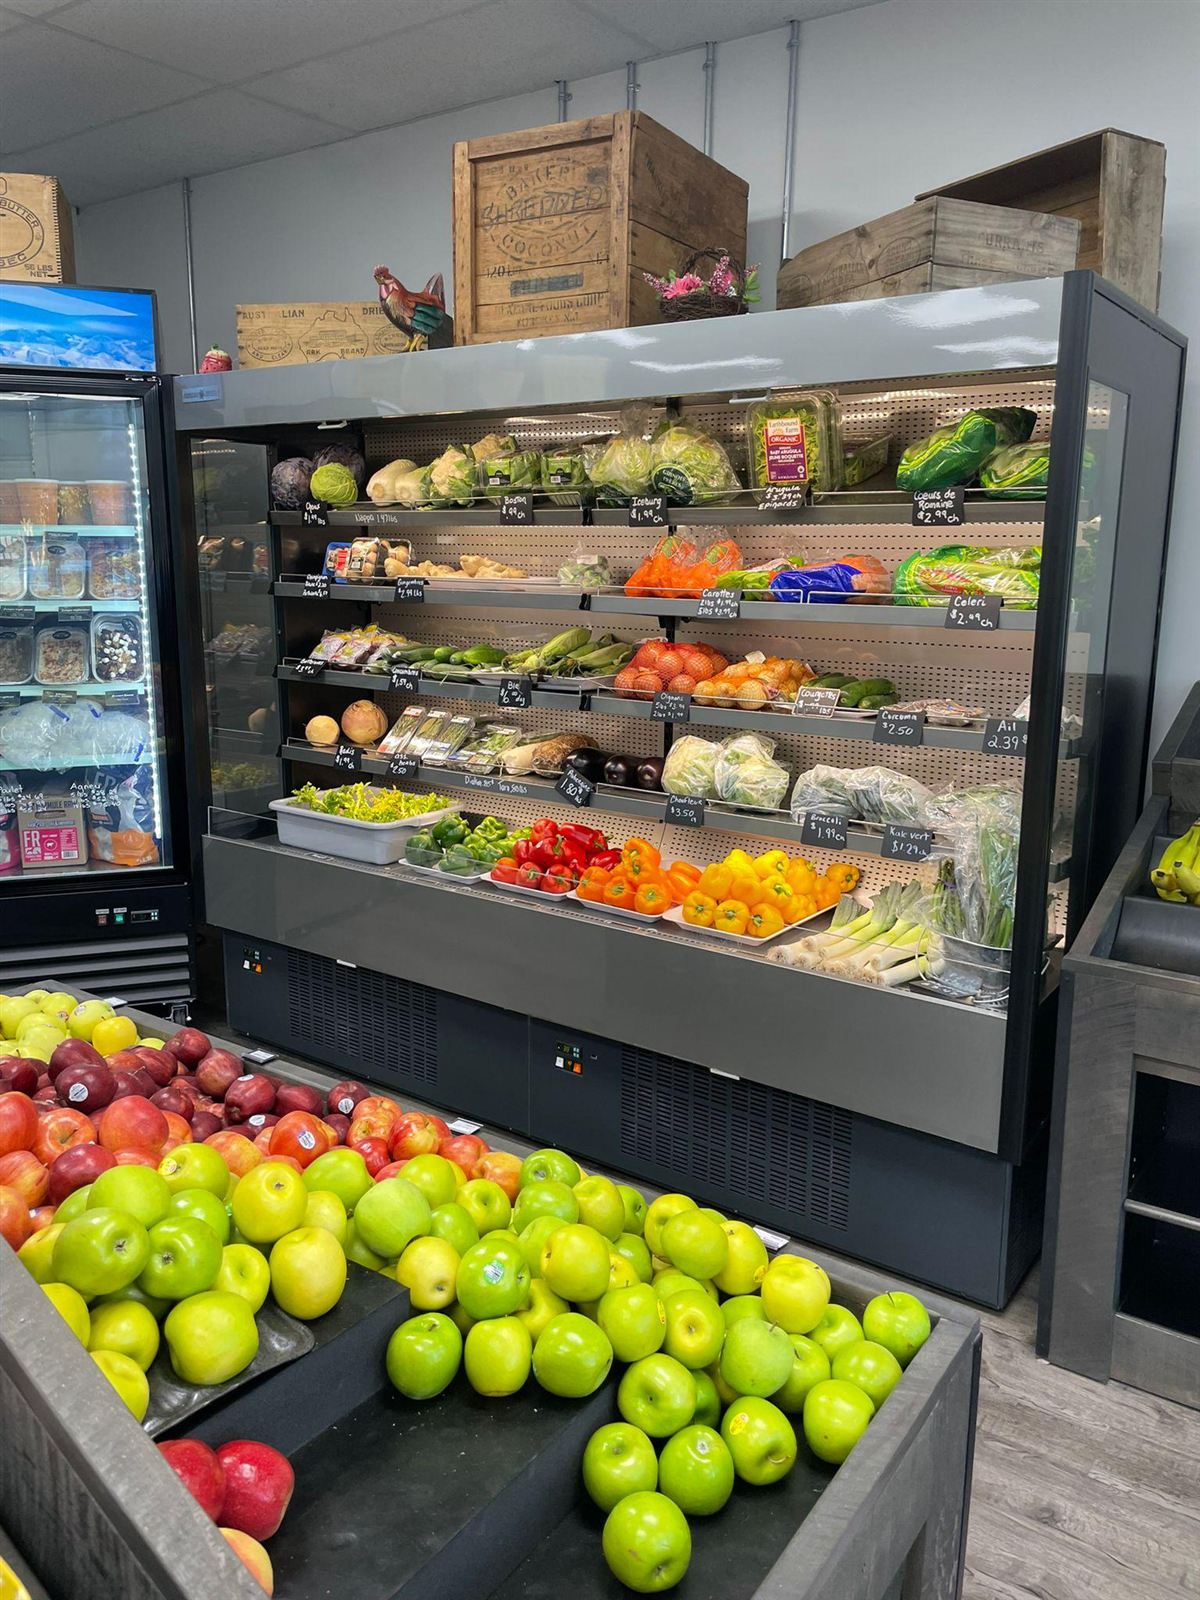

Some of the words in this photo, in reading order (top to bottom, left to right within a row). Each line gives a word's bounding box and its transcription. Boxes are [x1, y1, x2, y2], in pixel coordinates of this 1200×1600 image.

[770, 435, 798, 443] ORGANIC
[913, 490, 942, 501] Coeurs
[943, 488, 956, 499] de
[918, 499, 954, 511] Romaine
[947, 514, 960, 523] ch
[702, 588, 736, 599] Carottes
[980, 618, 993, 628] ch
[881, 722, 914, 735] $2.50
[997, 719, 1017, 733] Ail
[987, 735, 1020, 751] 2.39
[23, 830, 41, 848] FR
